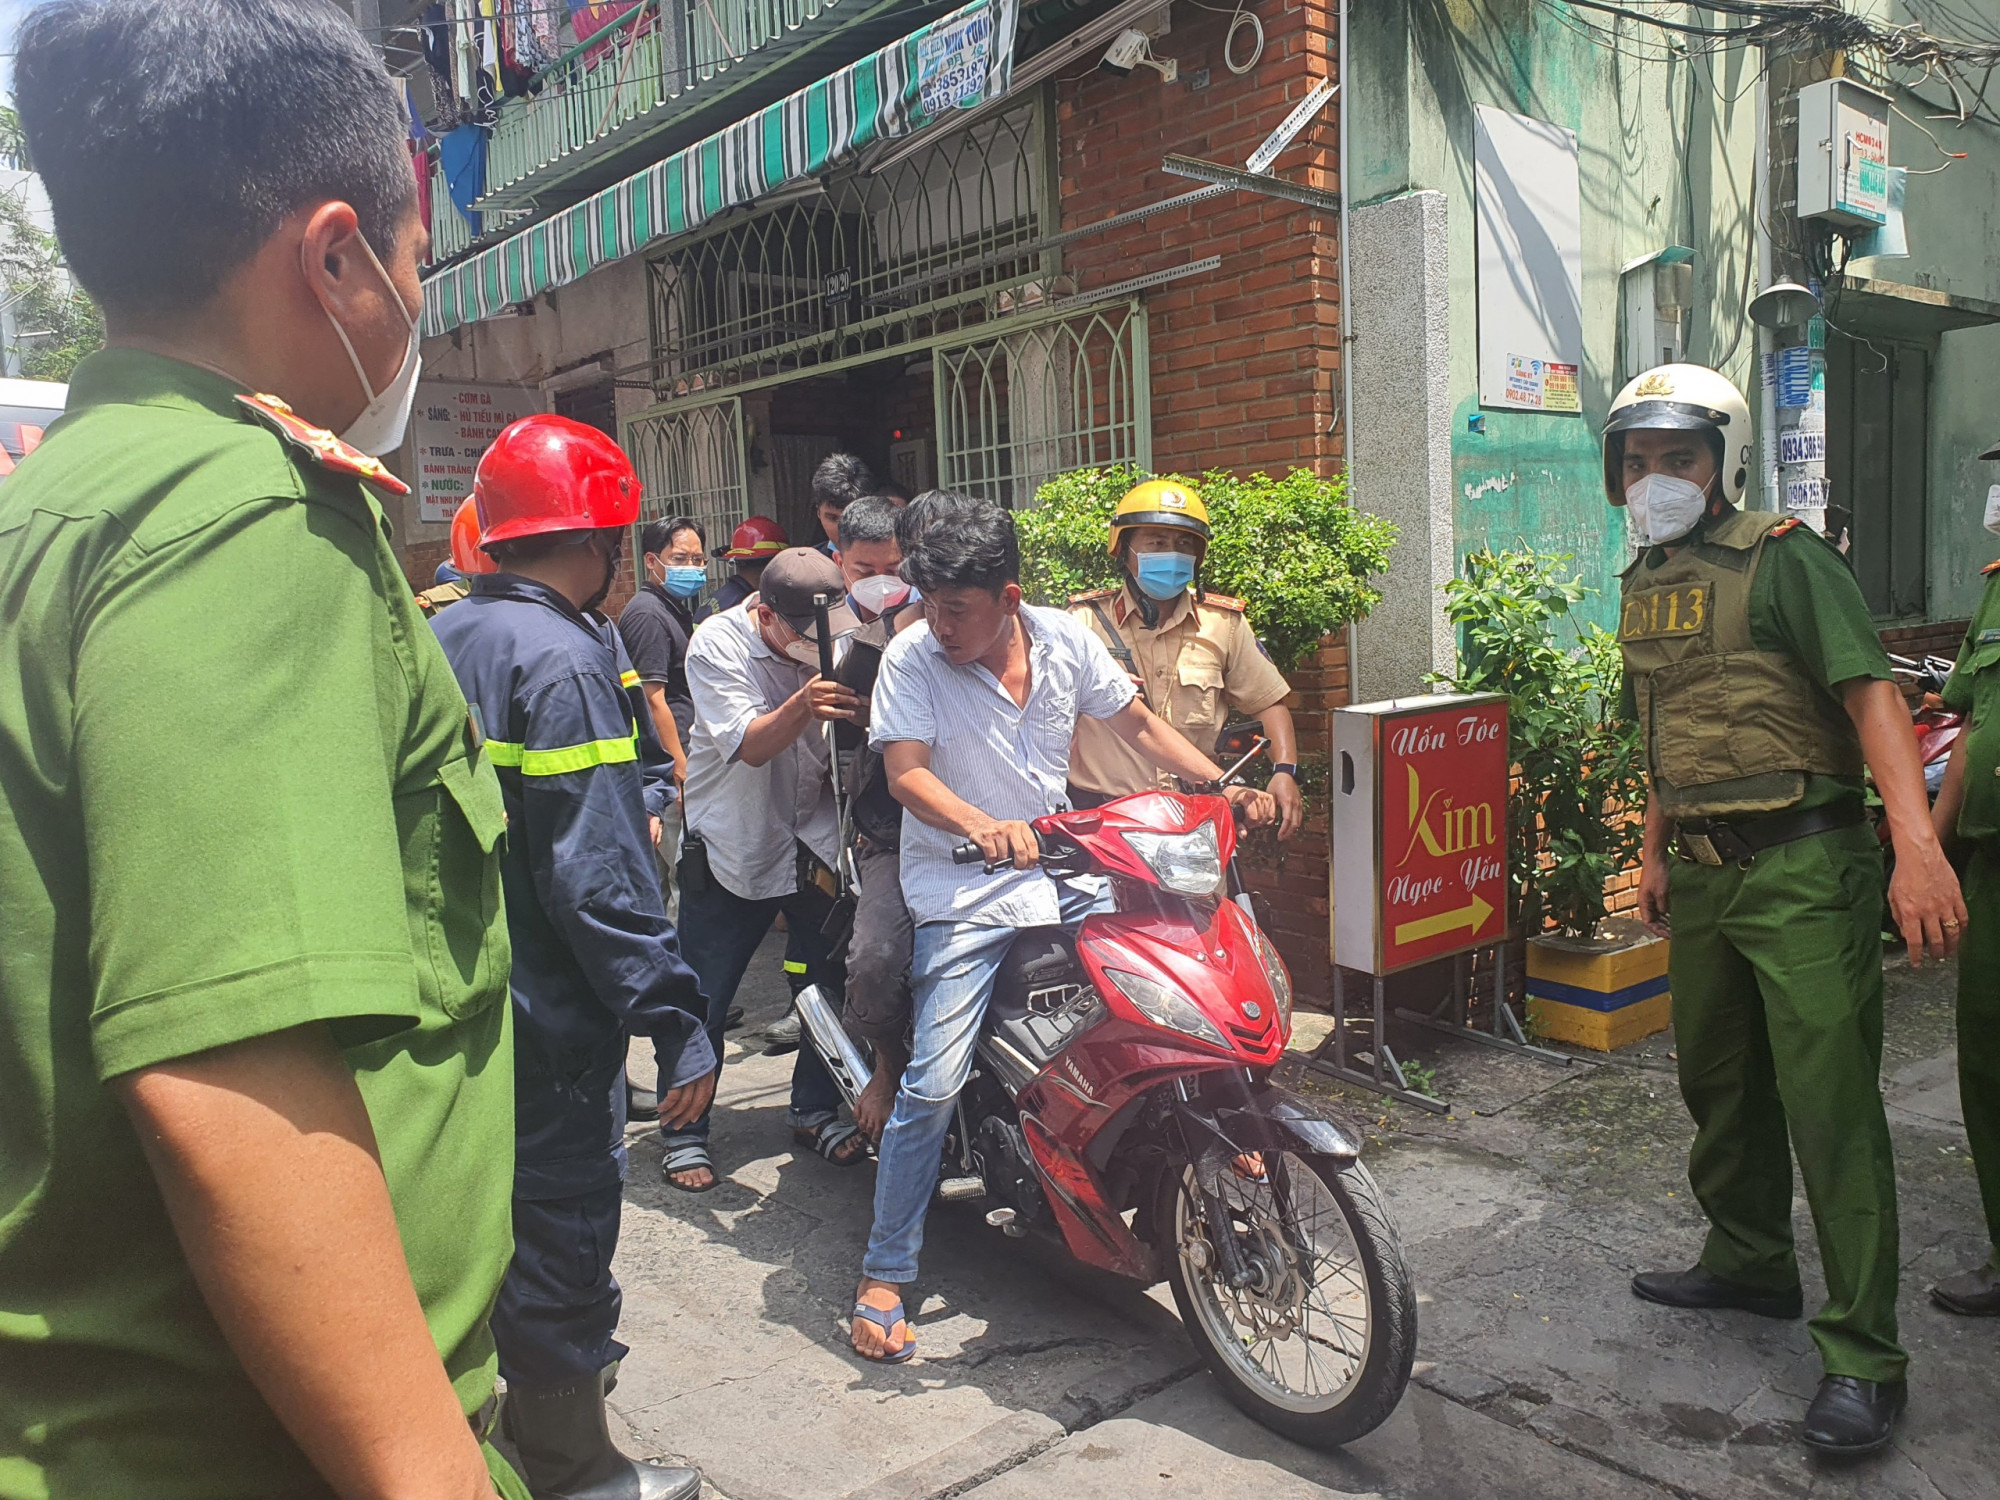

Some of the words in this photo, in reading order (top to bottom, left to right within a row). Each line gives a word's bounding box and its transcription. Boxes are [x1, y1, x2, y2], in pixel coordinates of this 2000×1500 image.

[826, 271, 849, 297] 120/20
[459, 392, 478, 405] CƠM
[480, 392, 492, 406] GÀ
[460, 408, 472, 421] HỦ
[473, 408, 492, 423] TIẾU
[494, 411, 505, 424] MÌ
[461, 427, 485, 440] BÁNH
[429, 446, 456, 458] TRƯA
[423, 463, 446, 475] BÁNH
[431, 478, 464, 491] NƯỚC:
[1391, 725, 1447, 757] Uốn
[1456, 716, 1500, 746] Tóc
[1394, 761, 1497, 868] Kim
[1387, 873, 1443, 907] Ngọc
[1459, 855, 1502, 893] Yến
[1065, 1055, 1094, 1097] YAMAHA
